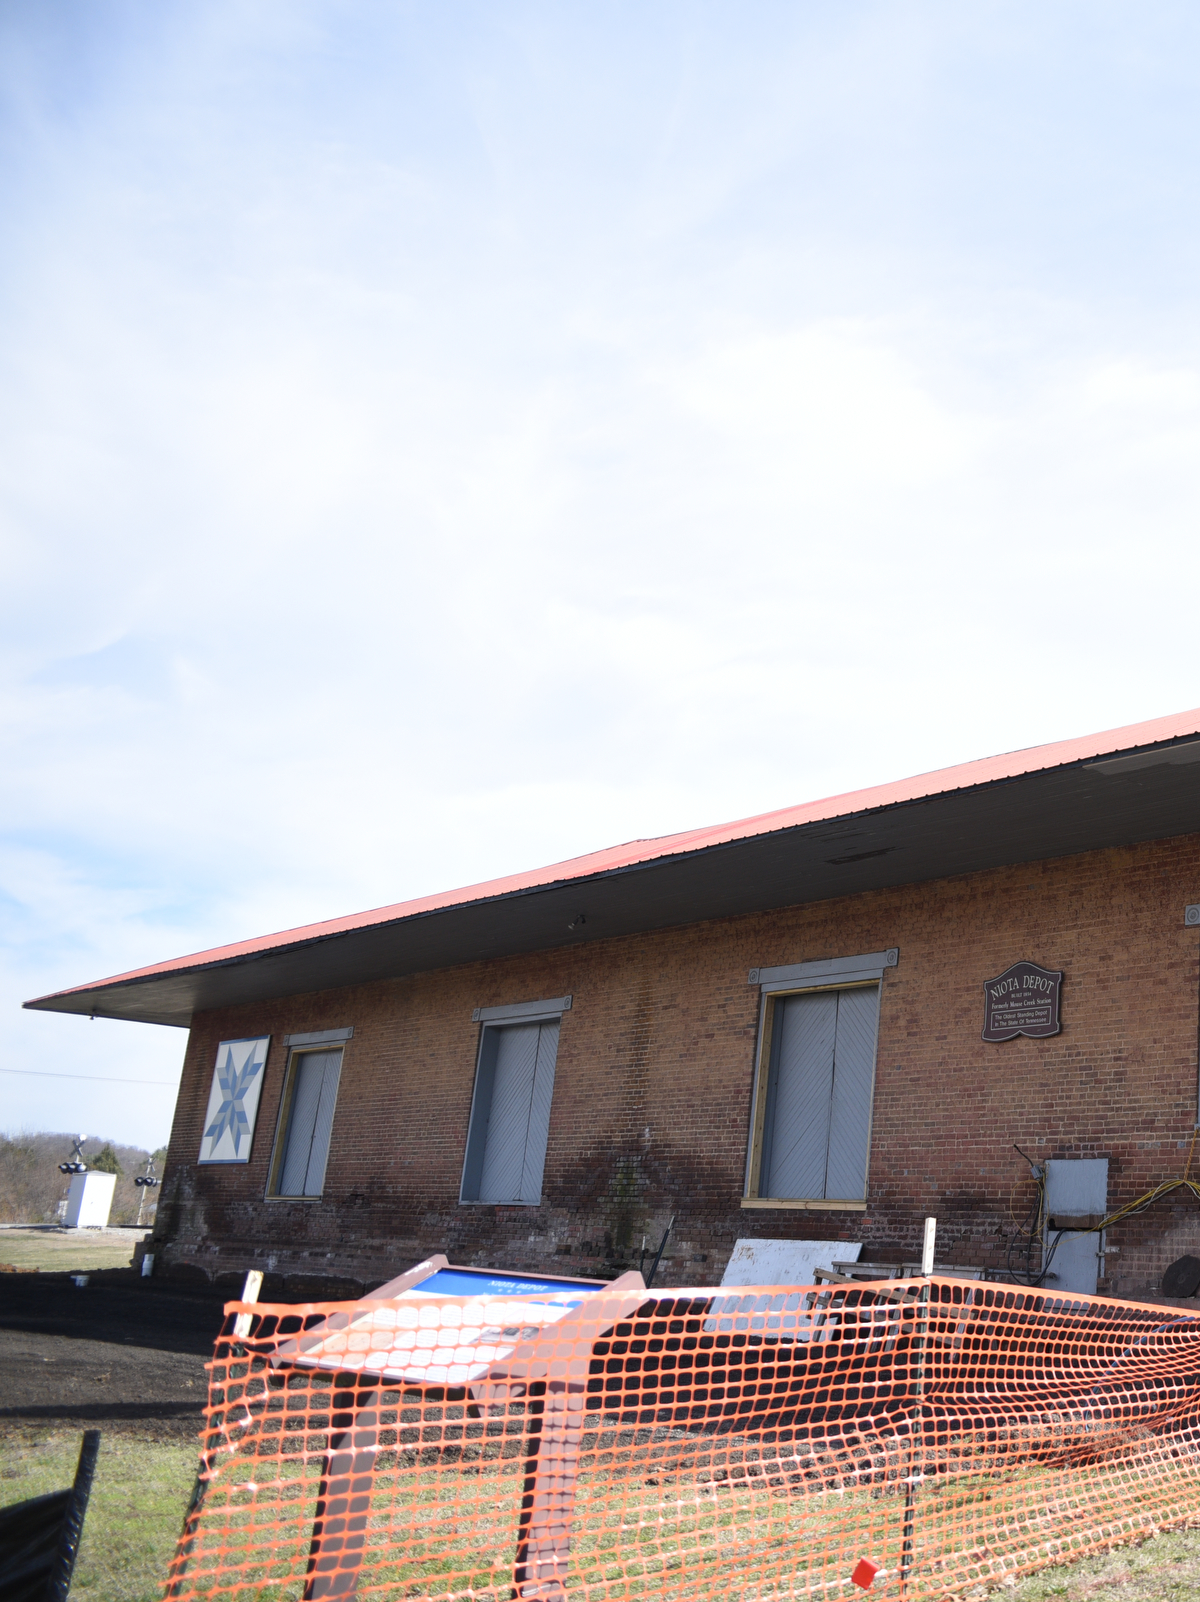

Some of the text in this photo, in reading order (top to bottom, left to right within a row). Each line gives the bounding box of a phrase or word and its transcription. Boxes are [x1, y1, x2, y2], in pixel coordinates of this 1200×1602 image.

[990, 975, 1054, 1001] NIOTA DEPOT
[488, 1280, 548, 1291] NIOTA DEPOT
